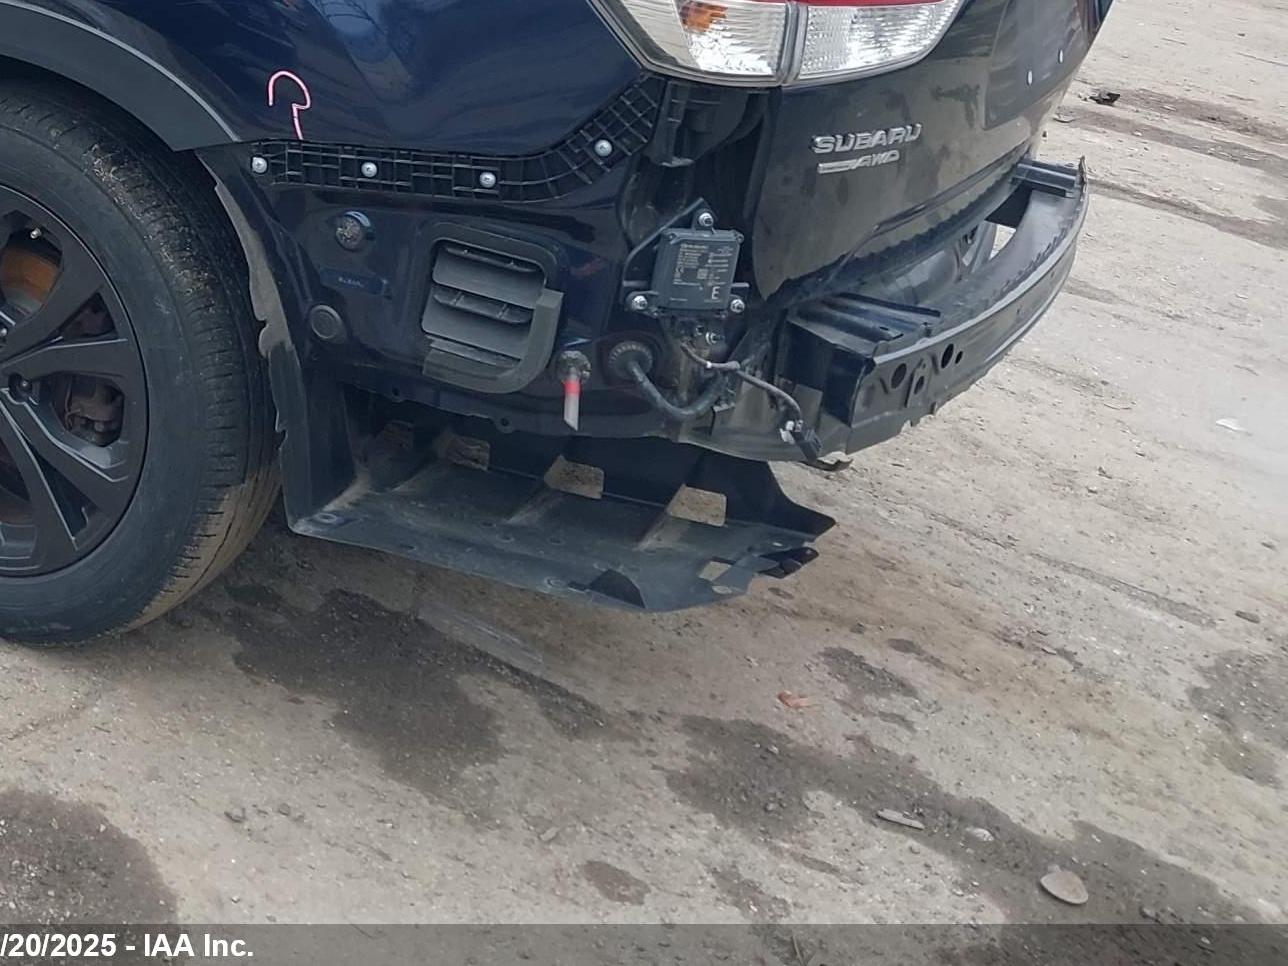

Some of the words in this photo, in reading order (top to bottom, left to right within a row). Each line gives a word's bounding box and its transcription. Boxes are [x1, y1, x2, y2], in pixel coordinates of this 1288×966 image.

[812, 122, 923, 155] SUBARU
[852, 149, 900, 169] AWD
[711, 285, 721, 300] E
